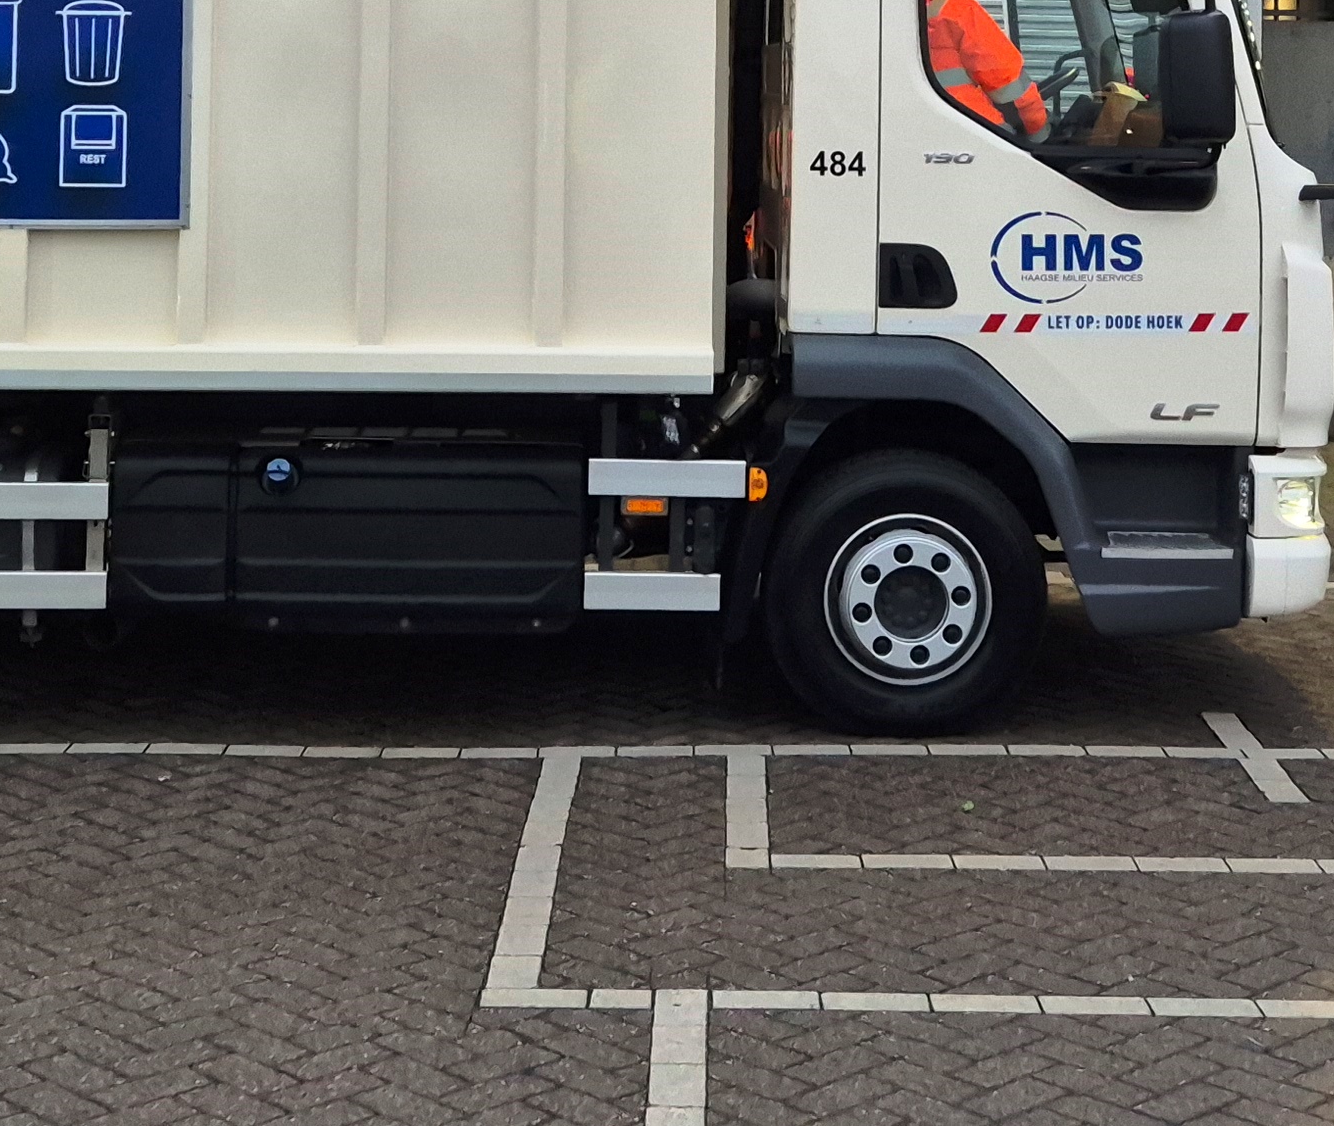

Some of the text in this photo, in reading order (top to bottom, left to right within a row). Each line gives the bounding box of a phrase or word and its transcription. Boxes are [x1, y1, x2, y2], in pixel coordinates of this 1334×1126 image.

[79, 153, 107, 164] REST
[809, 150, 866, 177] 484
[1021, 233, 1144, 272] HMS
[1021, 273, 1144, 282] HAAGSE MILIEU SERVICES
[1047, 315, 1184, 330] LET OP: DODE HOEK
[1149, 403, 1221, 422] LF
